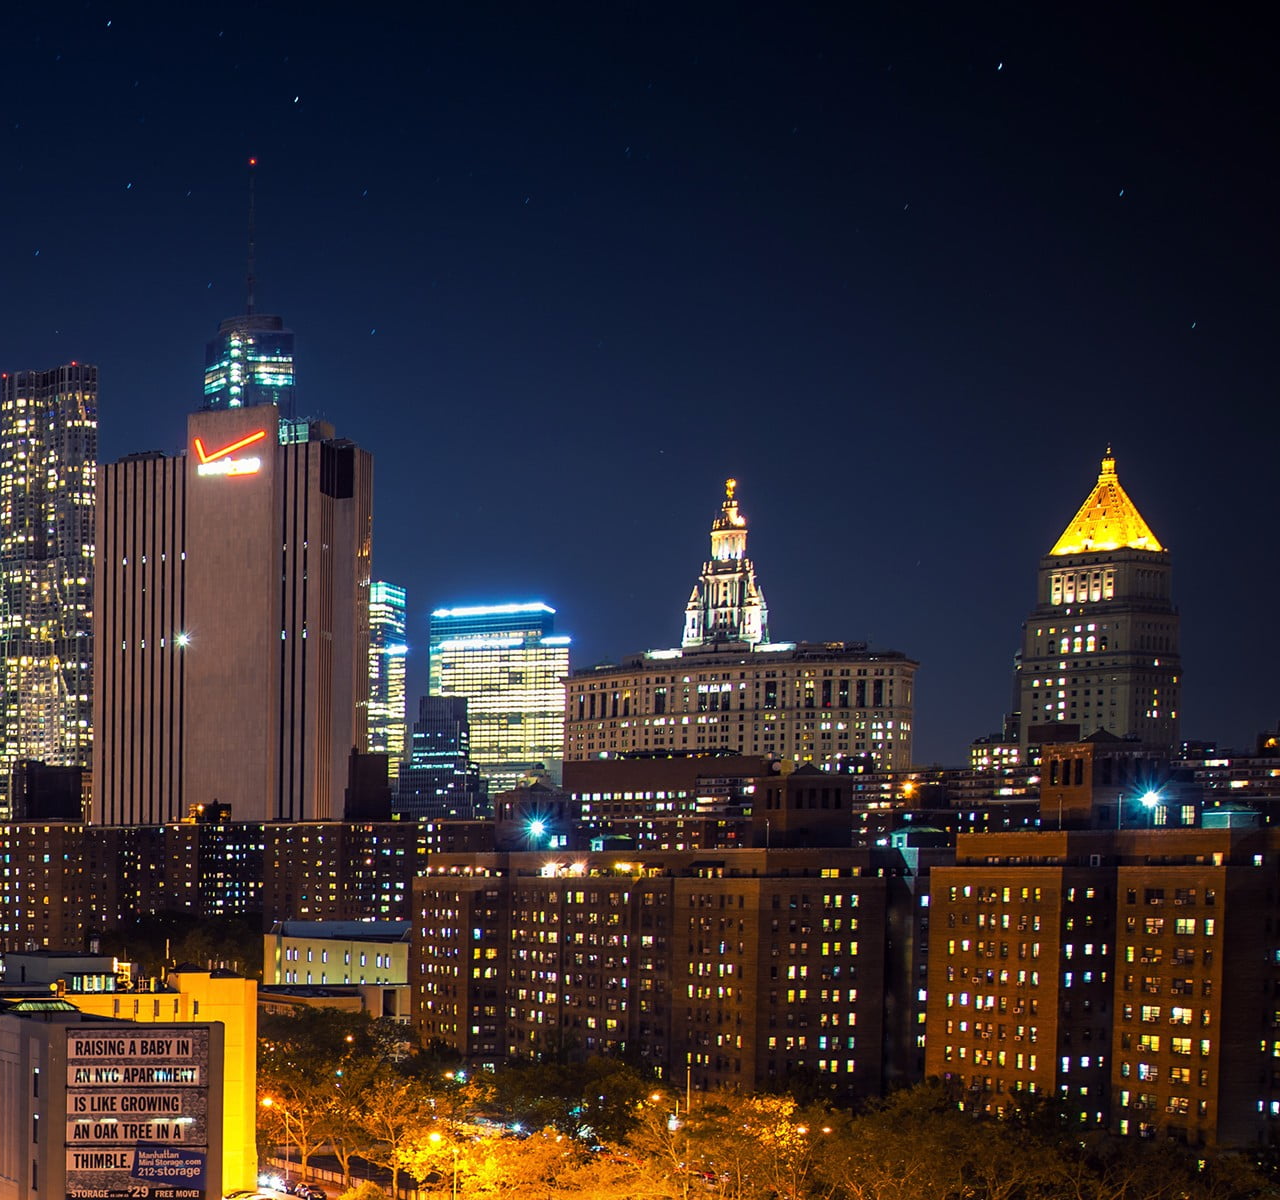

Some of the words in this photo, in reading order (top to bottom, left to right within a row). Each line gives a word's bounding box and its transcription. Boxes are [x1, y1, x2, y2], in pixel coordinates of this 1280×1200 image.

[75, 1040, 125, 1056] RAISING
[129, 1040, 137, 1056] A
[141, 1040, 173, 1055] BABY
[177, 1040, 189, 1055] IN
[74, 1068, 90, 1083] AN
[95, 1068, 119, 1083] NYC
[123, 1068, 196, 1083] APARTMENT
[74, 1097, 86, 1112] IS
[91, 1097, 117, 1112] LIKE
[121, 1097, 179, 1112] GROWING
[73, 1124, 90, 1139] AN
[94, 1124, 119, 1139] OAK
[122, 1124, 152, 1139] TREE
[156, 1124, 169, 1139] IN
[173, 1124, 181, 1139] A
[73, 1153, 131, 1169] THIMBLE.
[138, 1149, 180, 1159] Manhattan
[71, 1190, 109, 1198] STORAGE
[154, 1190, 175, 1198] FREE
[176, 1190, 200, 1198] MOVE!
